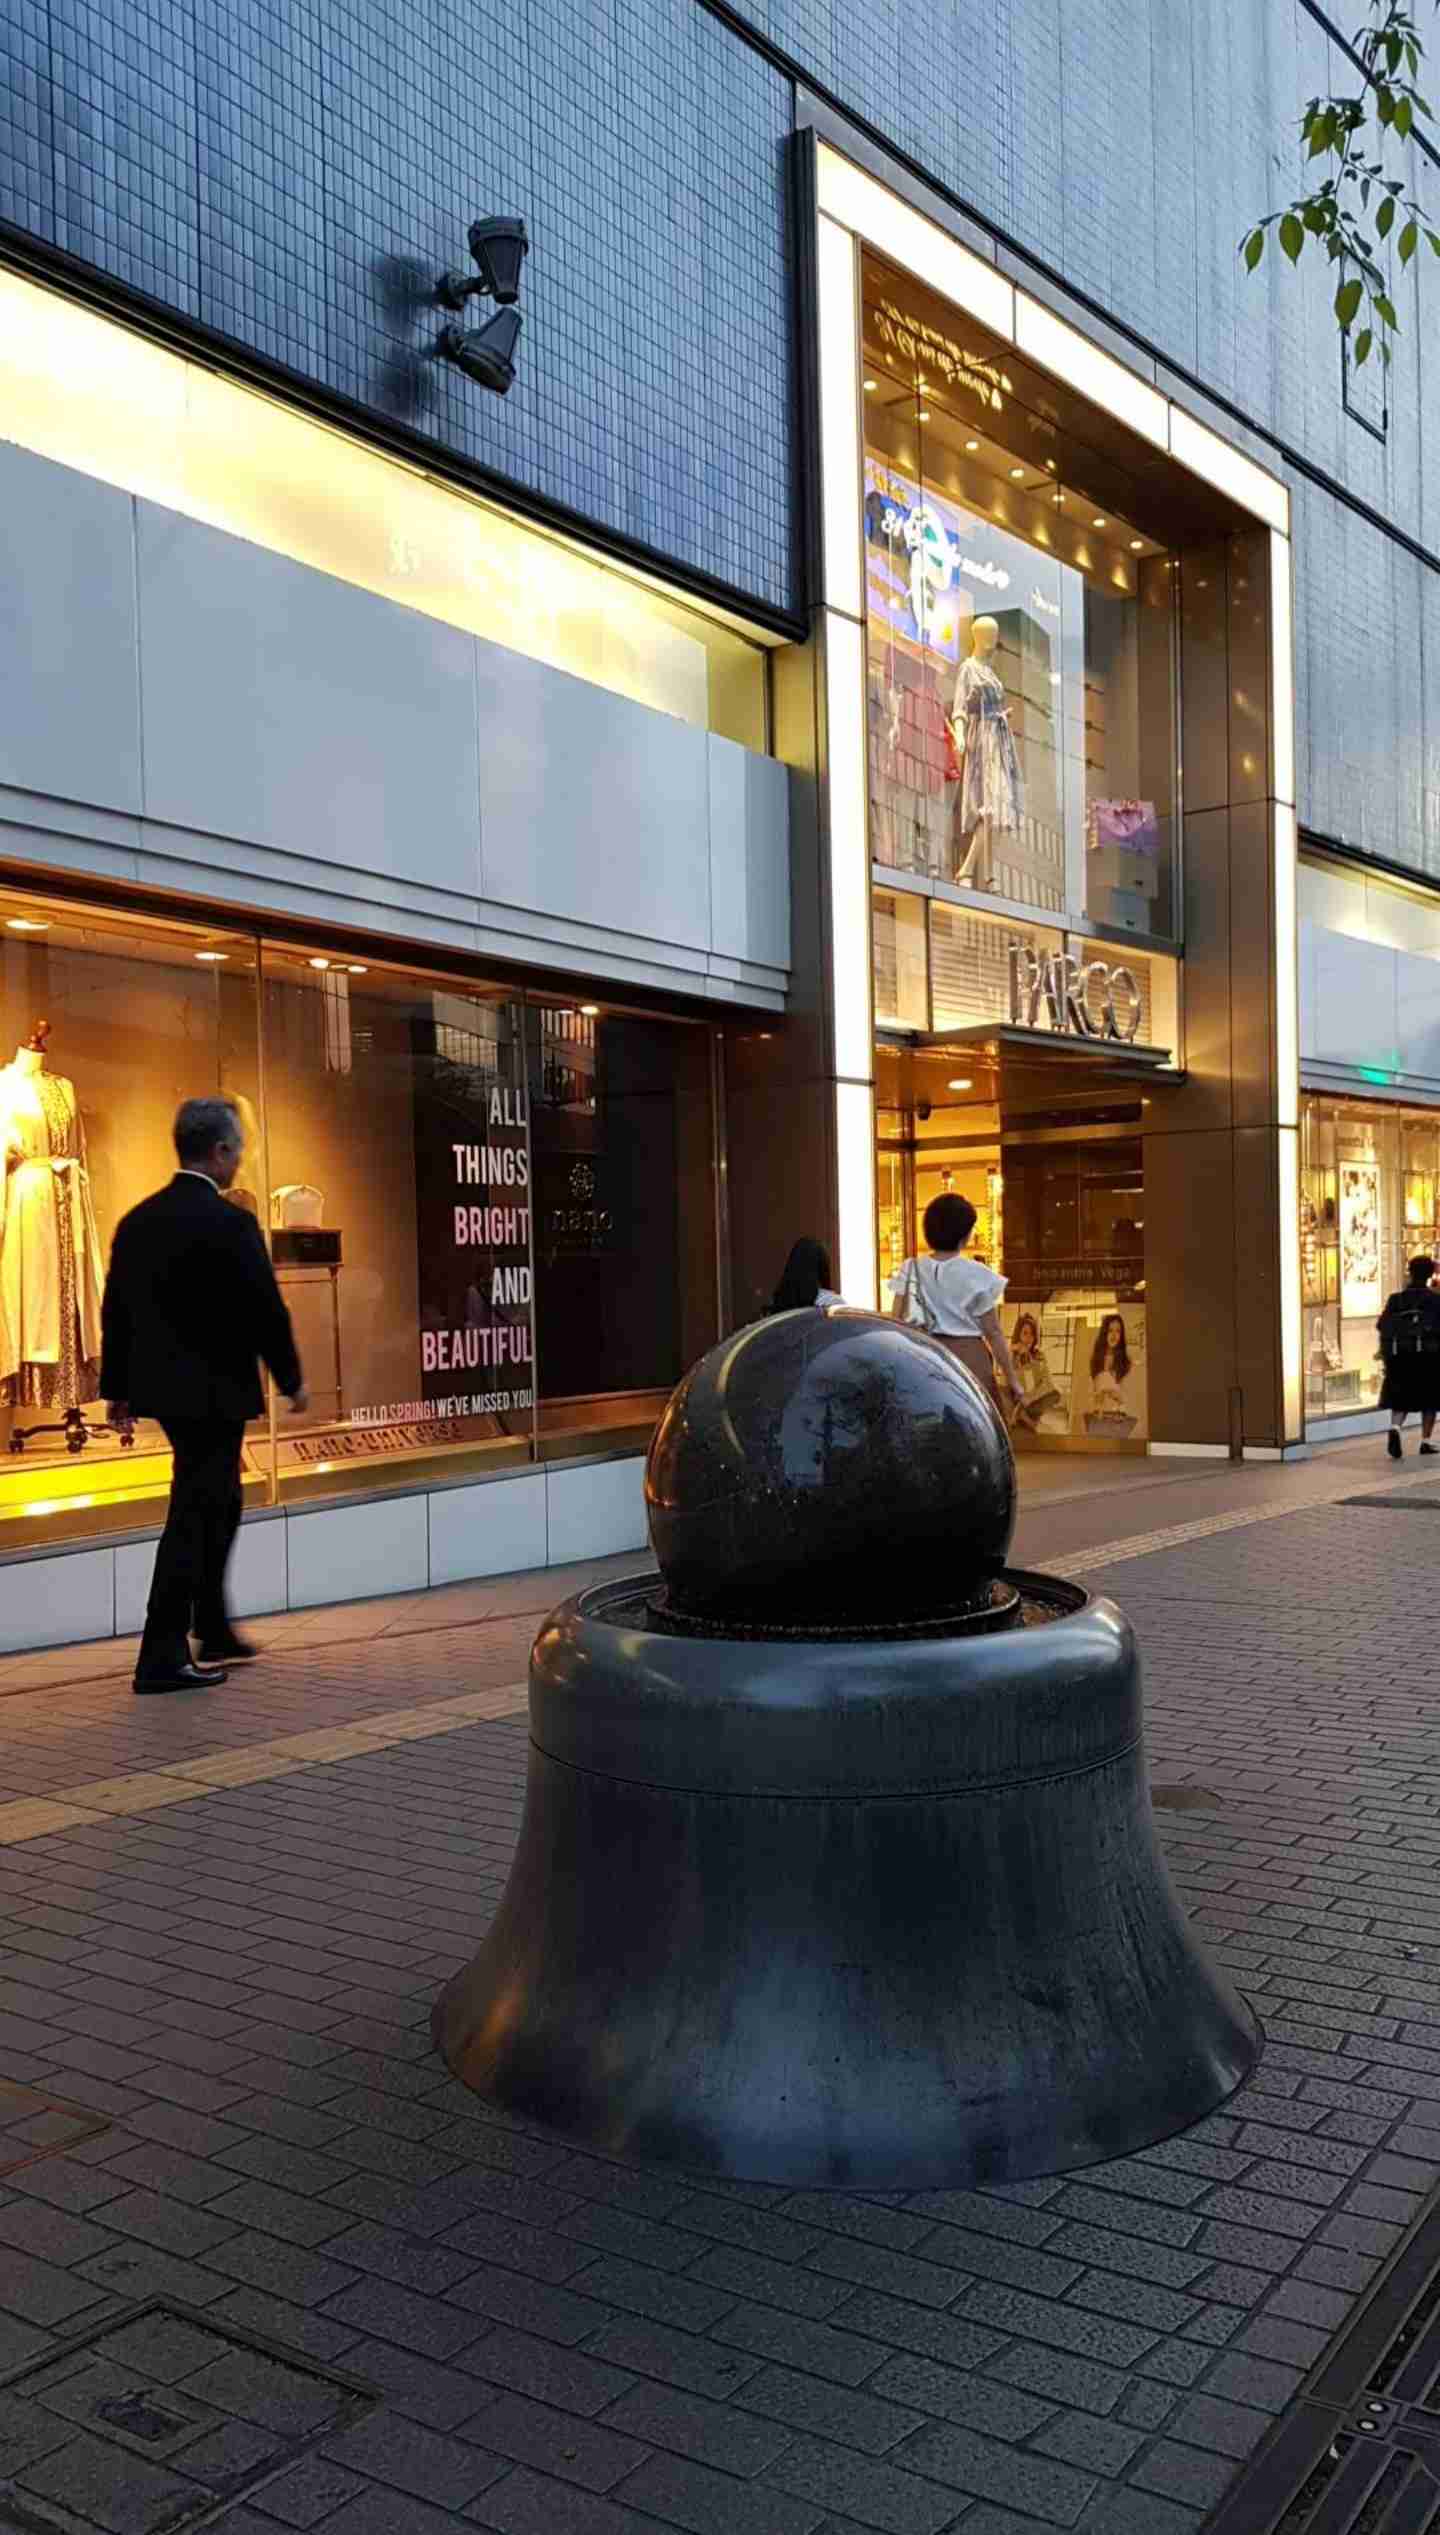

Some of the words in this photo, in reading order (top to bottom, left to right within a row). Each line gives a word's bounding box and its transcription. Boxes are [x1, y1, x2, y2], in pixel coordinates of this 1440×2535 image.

[1009, 943, 1141, 1039] PARCO
[488, 1087, 527, 1128] ALL
[452, 1144, 528, 1187] THINGS
[453, 1206, 530, 1247] BRIGHT
[490, 1266, 532, 1306] AND
[421, 1325, 533, 1372] BEAUTIFUL
[437, 1394, 470, 1418] WE'VE
[471, 1391, 510, 1415] MISSED
